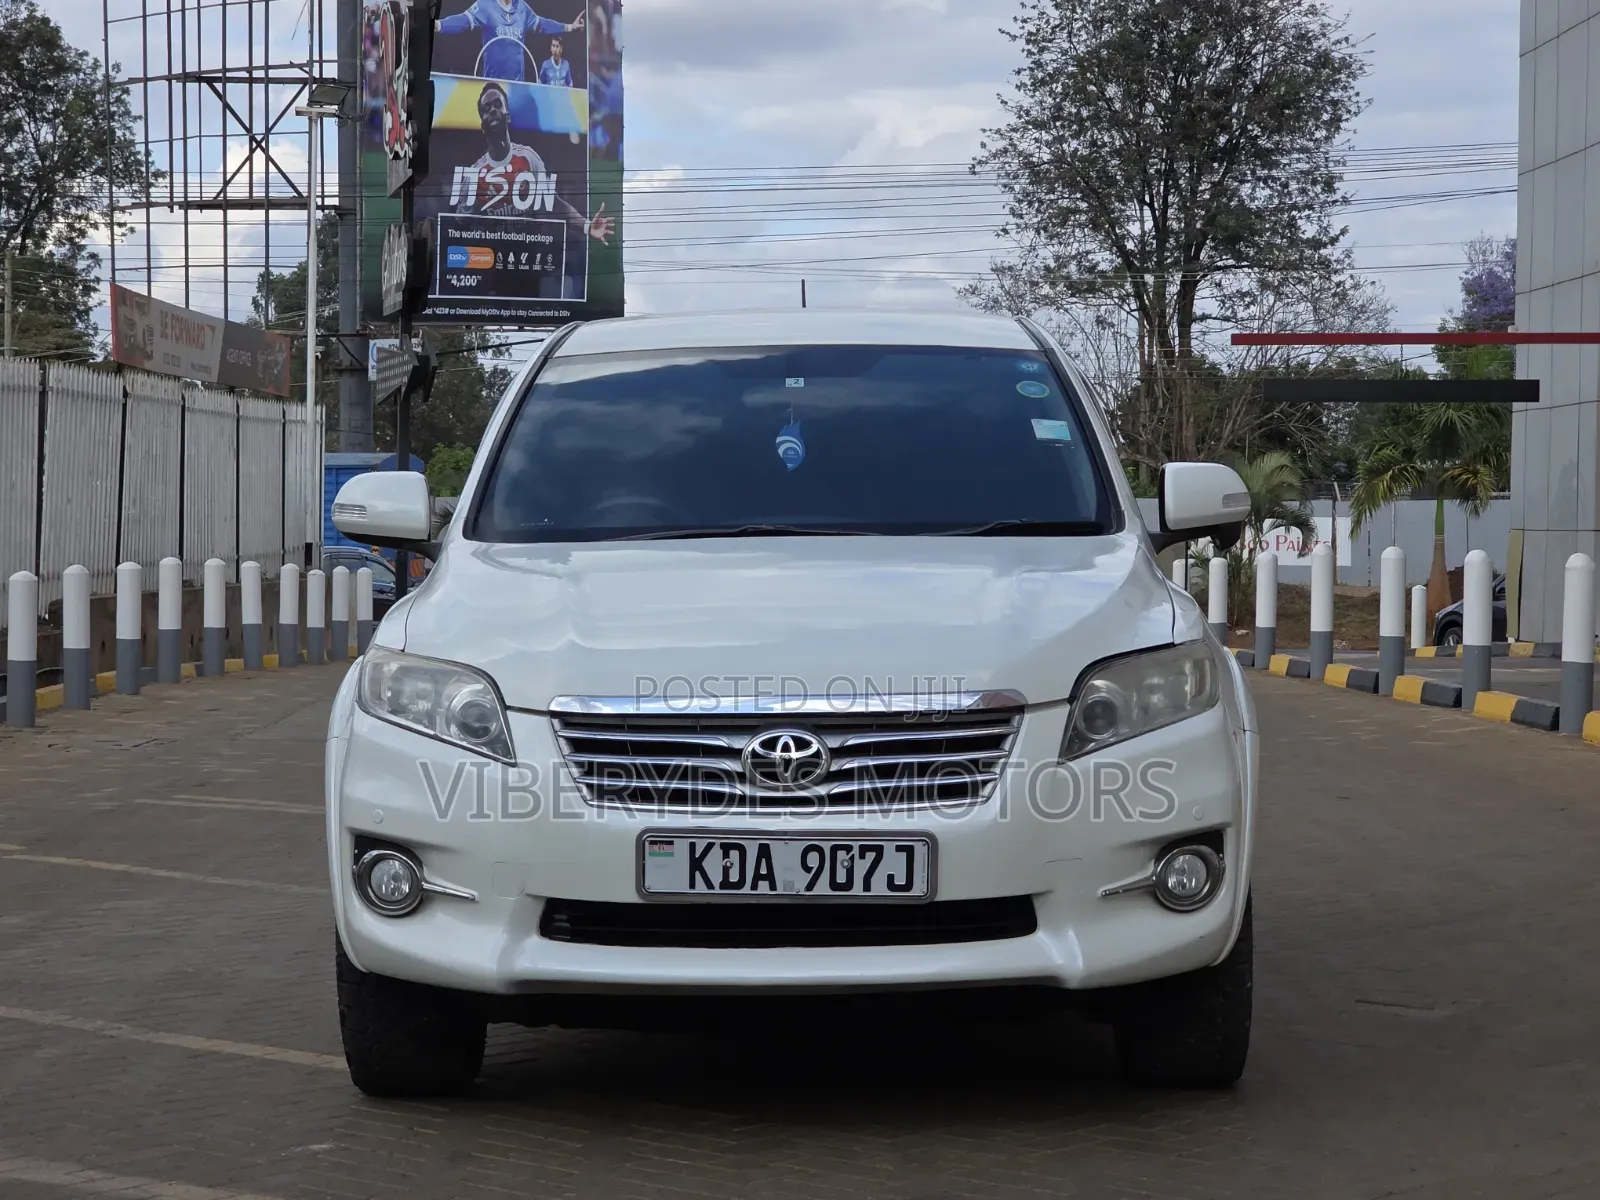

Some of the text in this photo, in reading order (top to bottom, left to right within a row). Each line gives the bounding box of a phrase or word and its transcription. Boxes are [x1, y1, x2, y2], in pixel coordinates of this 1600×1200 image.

[512, 171, 557, 212] ON
[448, 229, 554, 244] The world's best football package
[450, 274, 477, 287] 4,200
[456, 307, 481, 315] Download
[500, 308, 510, 317] App
[517, 309, 527, 317] stay
[688, 841, 778, 891] KDA
[800, 843, 915, 893] 907J
